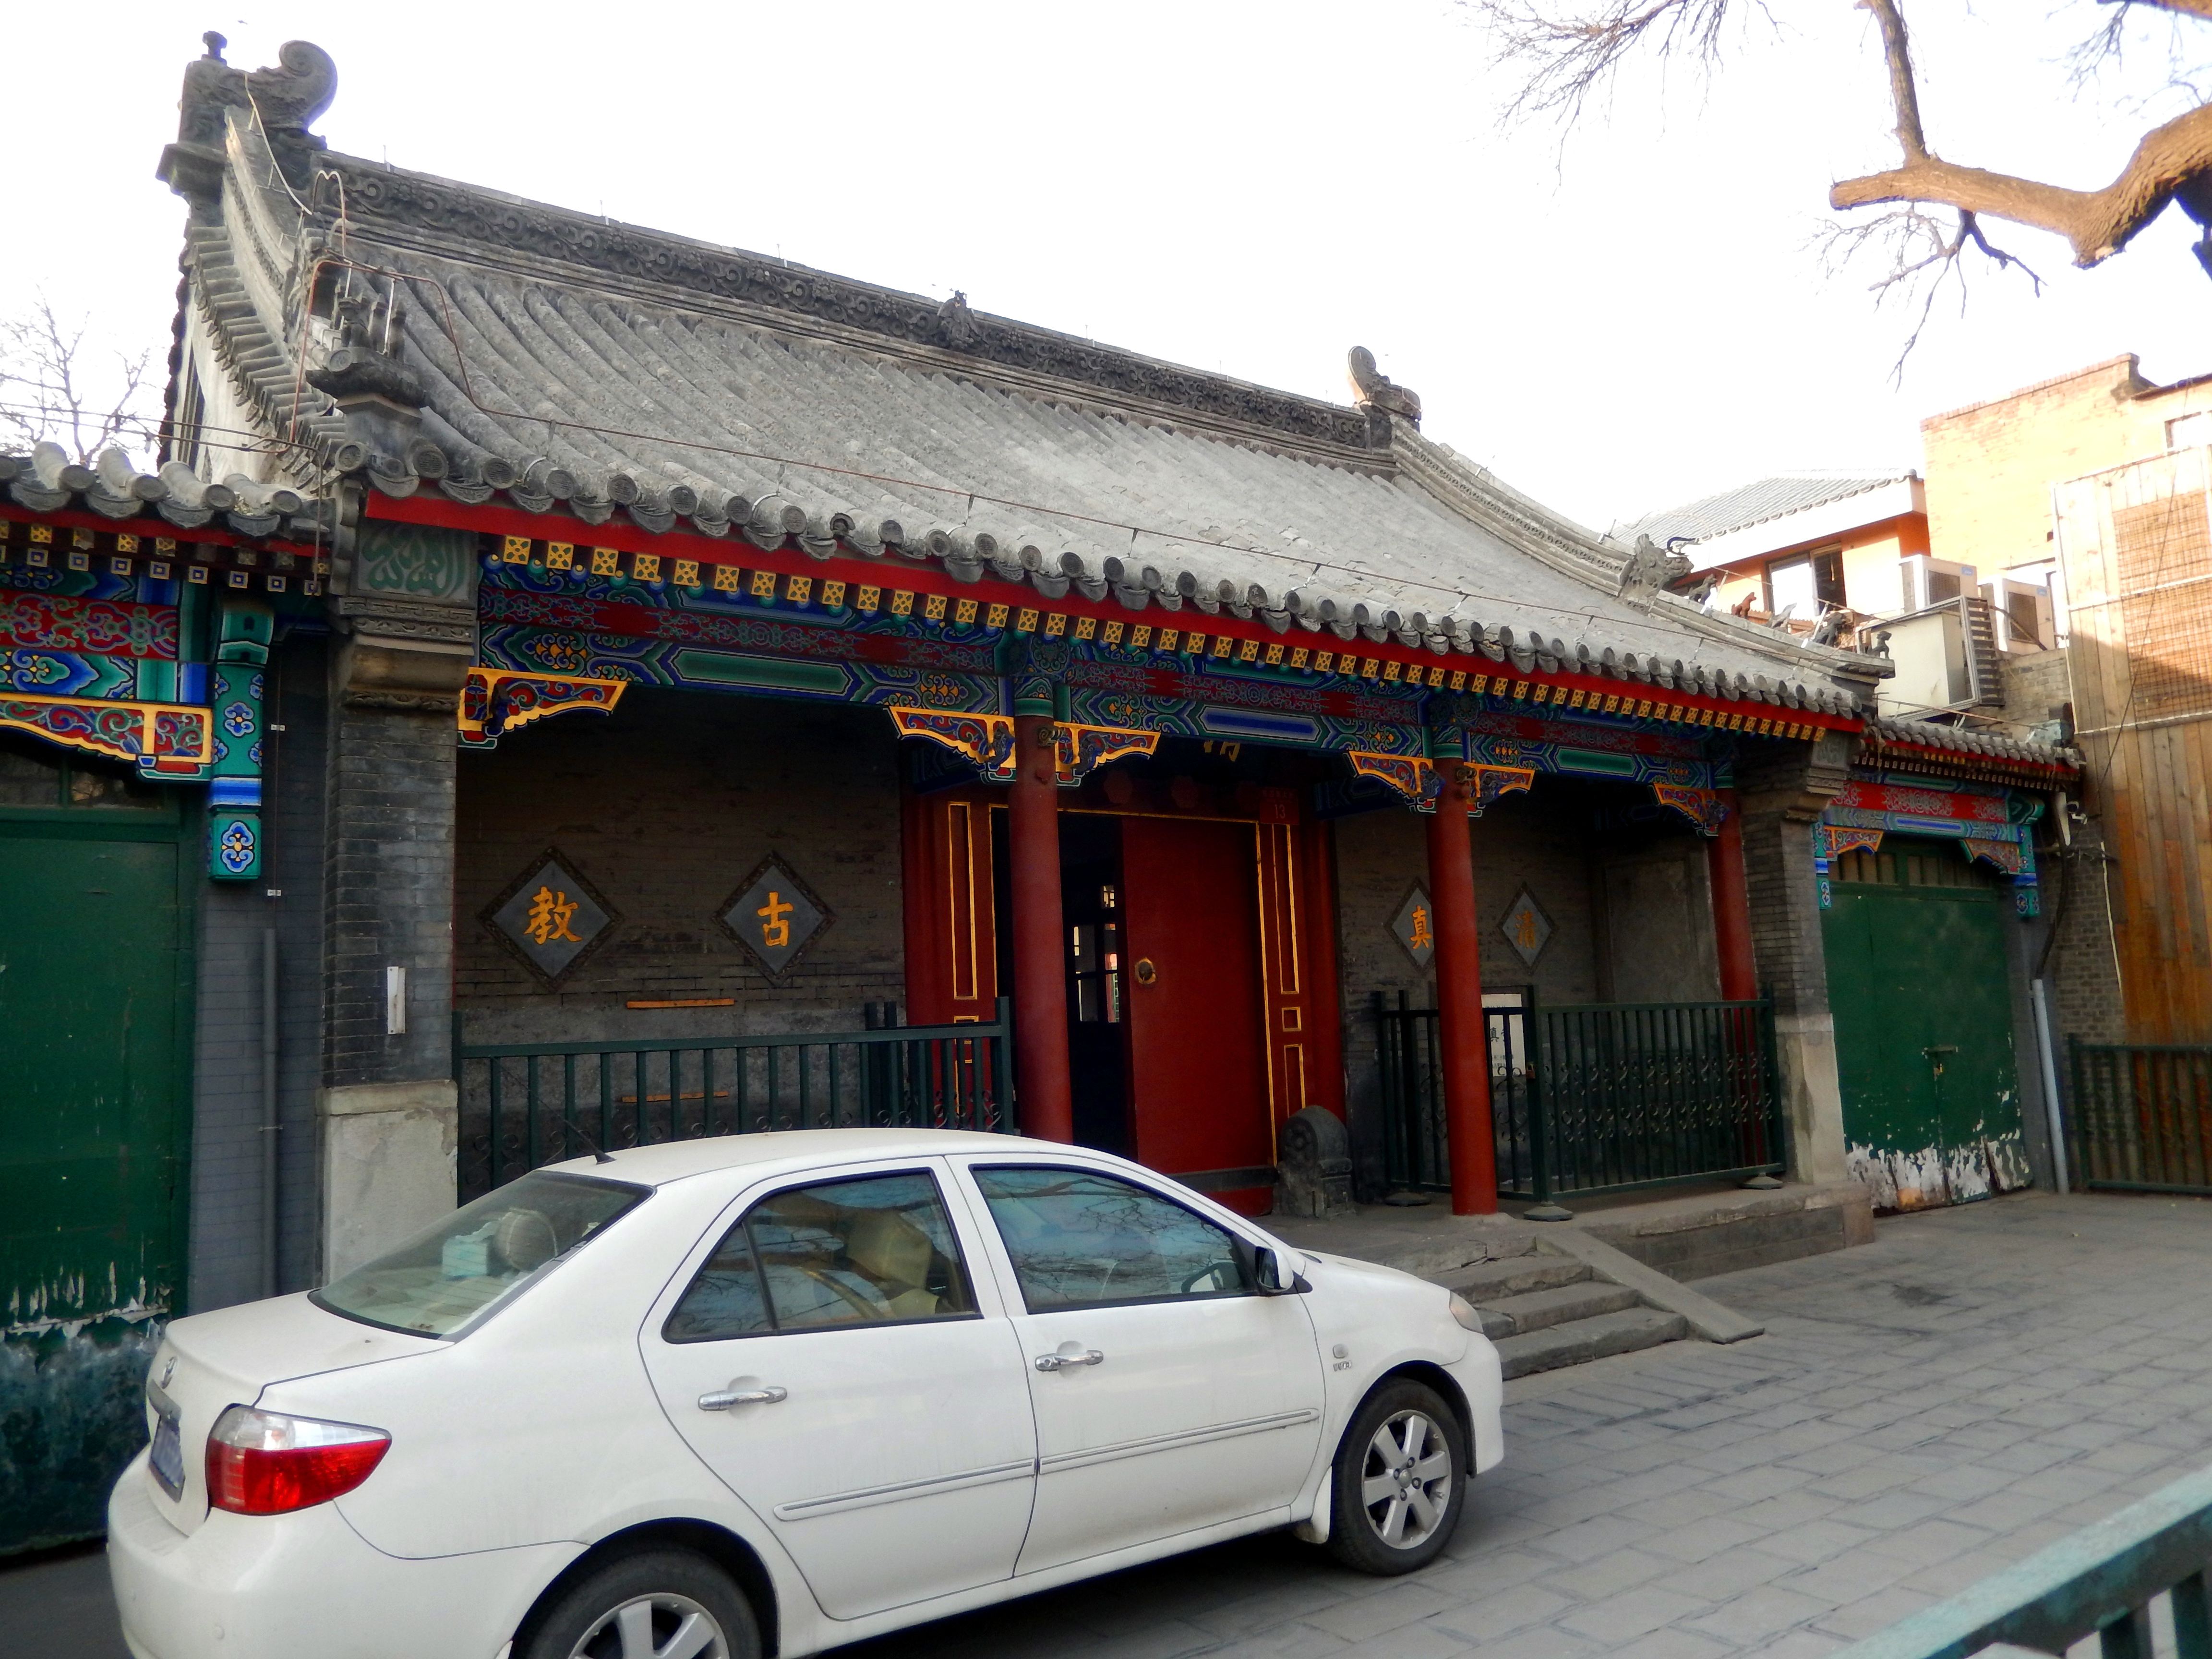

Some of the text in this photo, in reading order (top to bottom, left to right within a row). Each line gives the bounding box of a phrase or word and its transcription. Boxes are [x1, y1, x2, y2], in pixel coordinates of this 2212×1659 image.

[1274, 804, 1286, 819] 13
[524, 886, 583, 945] 教
[757, 891, 793, 947] 古
[1409, 905, 1432, 950] 真
[1515, 910, 1536, 949] 清
[1490, 1027, 1504, 1043] 真
